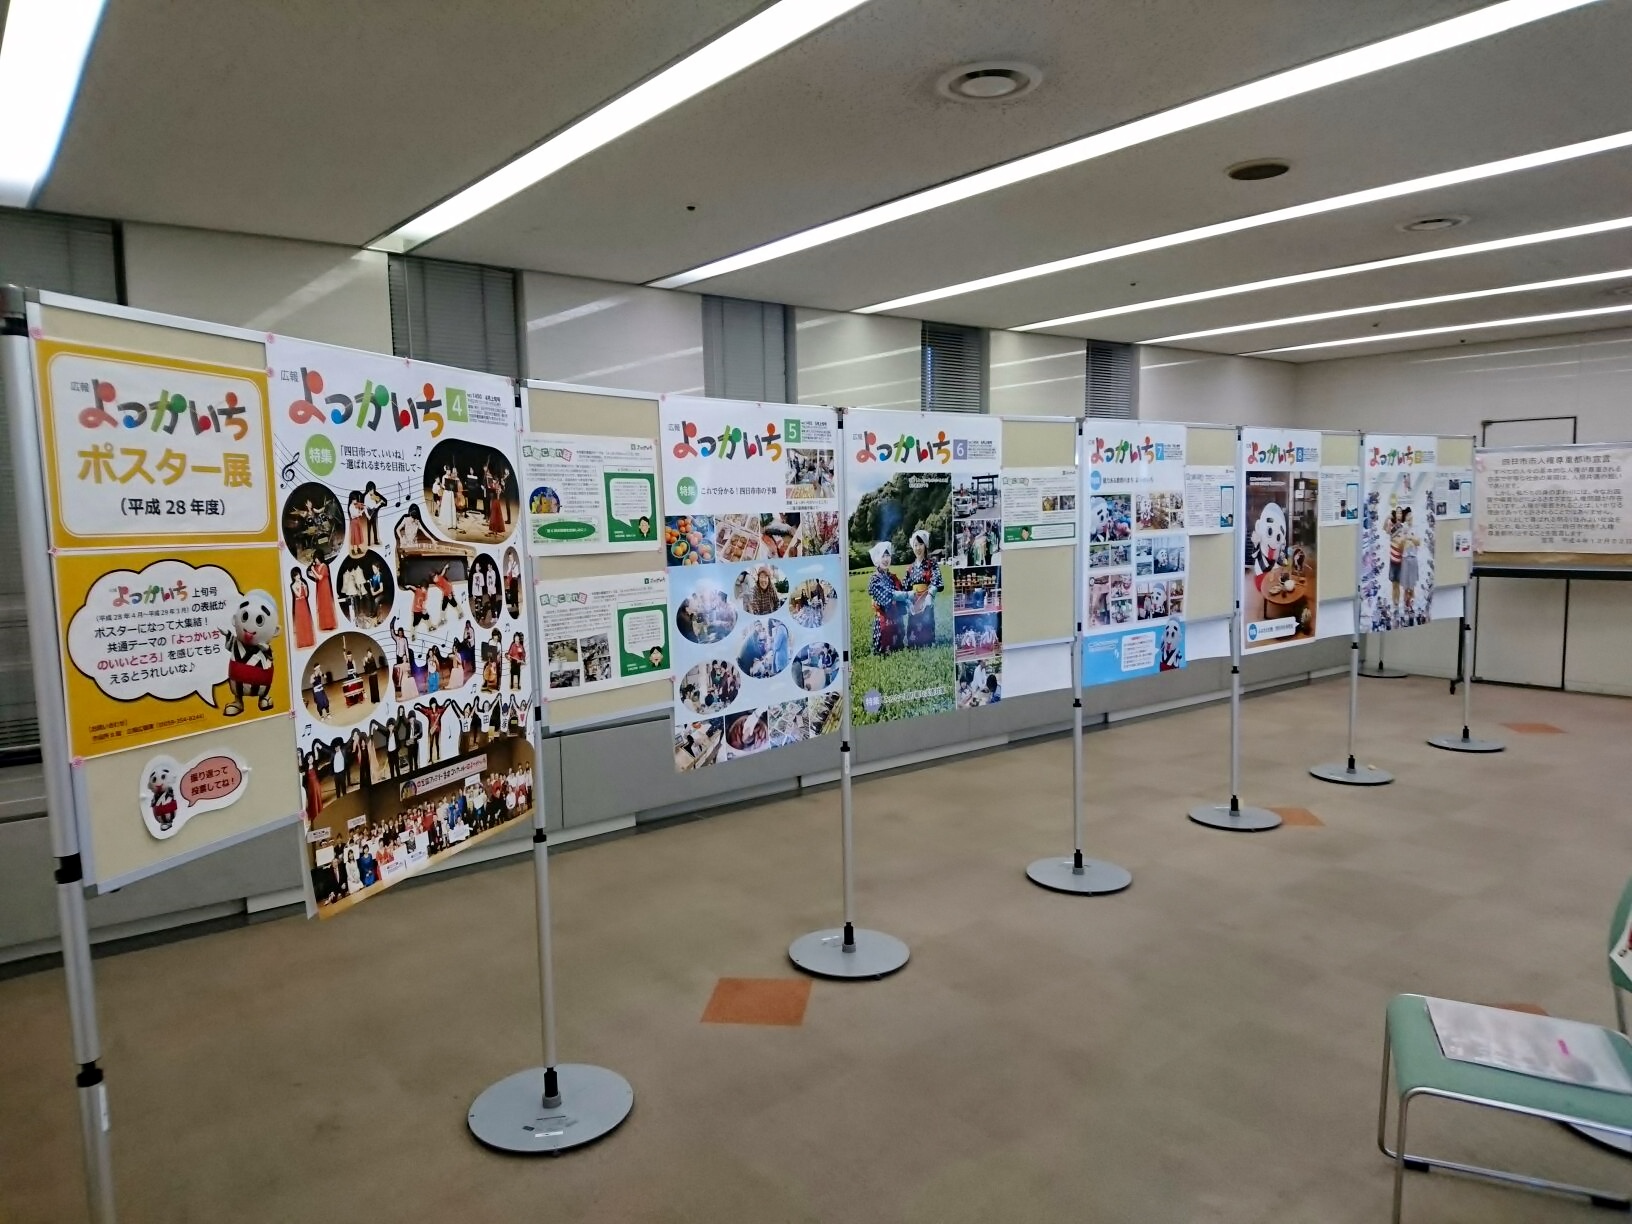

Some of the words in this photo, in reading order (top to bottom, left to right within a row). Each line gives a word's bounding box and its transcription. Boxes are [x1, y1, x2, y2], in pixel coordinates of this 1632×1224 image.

[70, 381, 90, 393] 広報
[79, 378, 249, 441] よっかいち
[289, 367, 444, 438] よっかいち
[452, 395, 463, 416] 4
[673, 421, 783, 462] よっかいち
[788, 427, 798, 440] 5
[856, 431, 951, 464] よっかいち
[956, 442, 965, 458] 6
[1091, 436, 1154, 464] よっかいち
[1247, 441, 1295, 465] よっかいち
[77, 442, 253, 488] ポスター展
[309, 447, 333, 465] 特集
[679, 485, 697, 497] 特集
[112, 580, 188, 608] よっかいち
[192, 586, 218, 598] 上旬号
[192, 600, 226, 613] の表紙が
[94, 616, 209, 639] ポスターになって大集結！
[107, 629, 221, 653] 共通テーマの「よっかいち
[191, 766, 228, 783] 振り返って
[191, 778, 234, 796] 投票してね！
